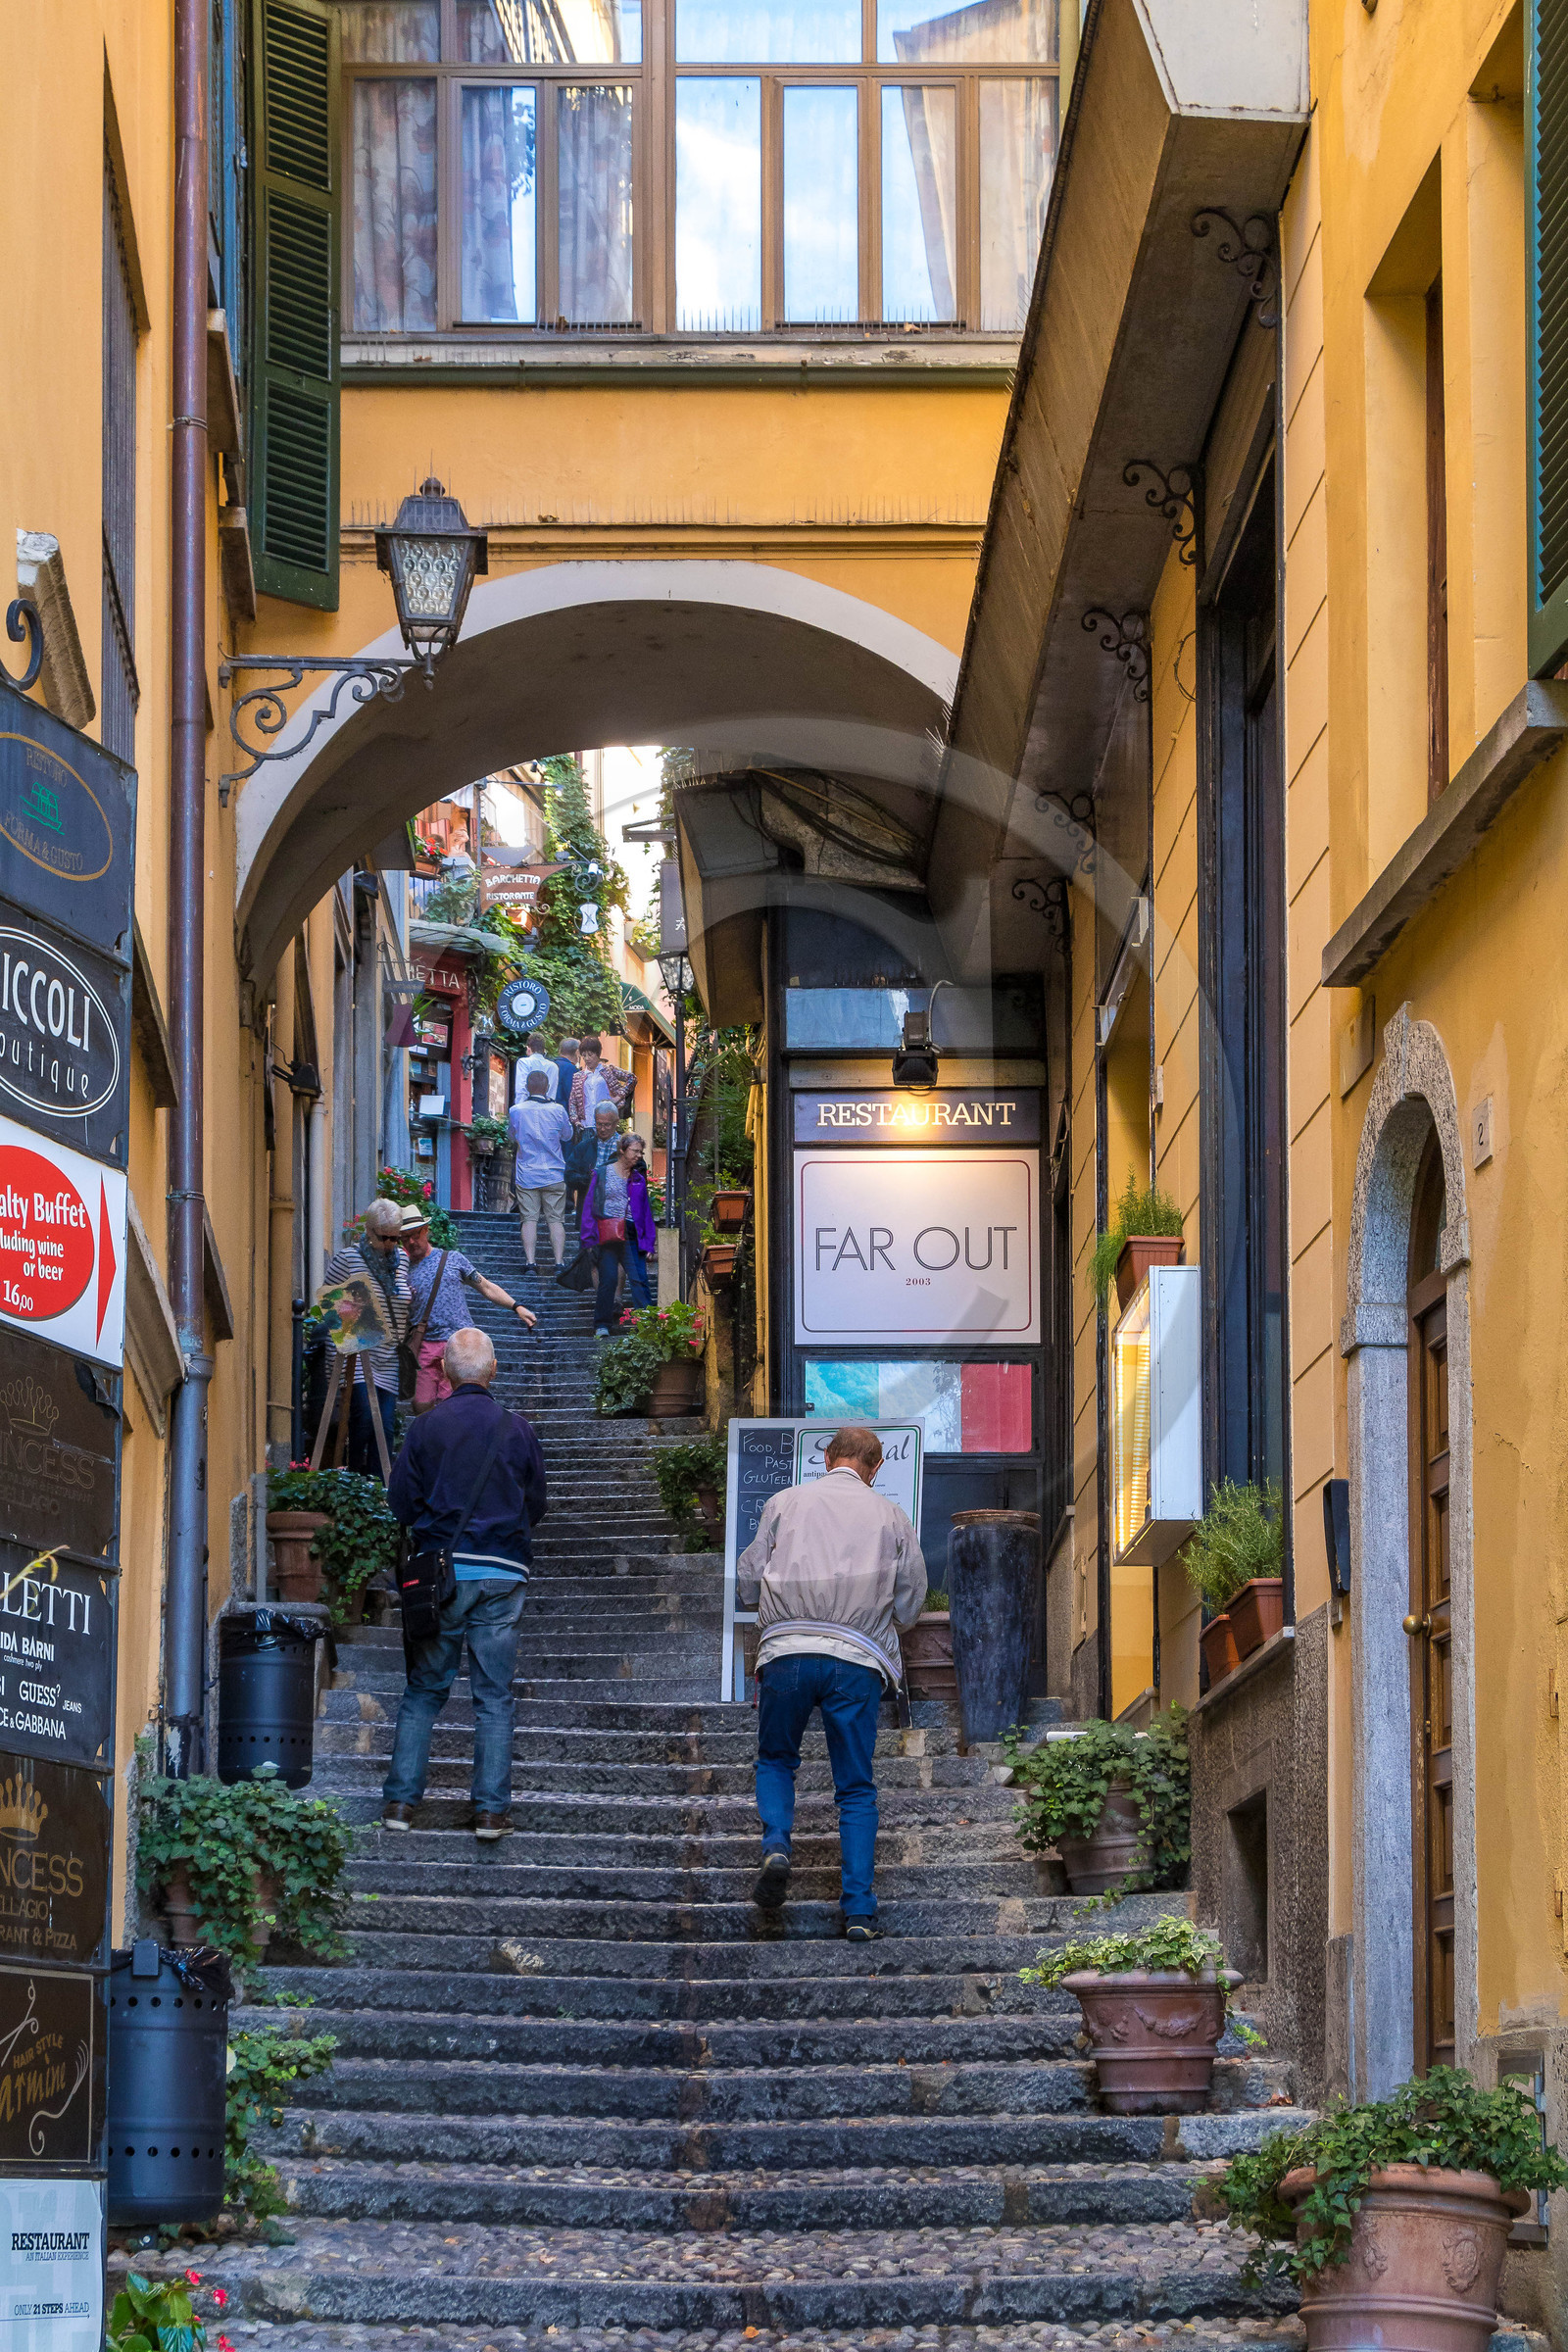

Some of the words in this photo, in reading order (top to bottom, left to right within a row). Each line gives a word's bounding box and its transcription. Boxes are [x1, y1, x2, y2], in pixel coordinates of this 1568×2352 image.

[42, 841, 49, 861] &
[50, 846, 83, 871] GUSTO
[484, 873, 541, 888] BARCHETTA
[486, 892, 535, 901] RISTORANTE
[503, 980, 542, 997] RISTORO
[2, 952, 91, 1052] ICCOLI
[500, 1004, 519, 1029] FORMA
[526, 1003, 547, 1028] GUSTO
[816, 1102, 1016, 1127] RESTAURANT
[33, 1192, 86, 1229] Buffet
[37, 1236, 65, 1258] wine
[815, 1226, 896, 1271] FAR
[913, 1226, 1017, 1271] OUT
[23, 1261, 36, 1277] or
[38, 1257, 64, 1281] beer
[906, 1277, 931, 1286] 2003
[22, 1636, 55, 1662] BARNI
[19, 1680, 62, 1708] GUESS?
[62, 1699, 82, 1714] JEANS
[15, 1710, 67, 1740] GABBANA
[45, 1928, 78, 1951] PIZZA
[13, 2046, 35, 2069] HAIR
[35, 2033, 64, 2055] STYLE
[11, 2231, 90, 2251] RESTAURANT
[35, 2251, 57, 2262] ITALIAN
[14, 2304, 32, 2316] ONLY
[33, 2304, 41, 2315] 21
[41, 2302, 64, 2315] STEPS
[64, 2301, 90, 2314] AHEAD
